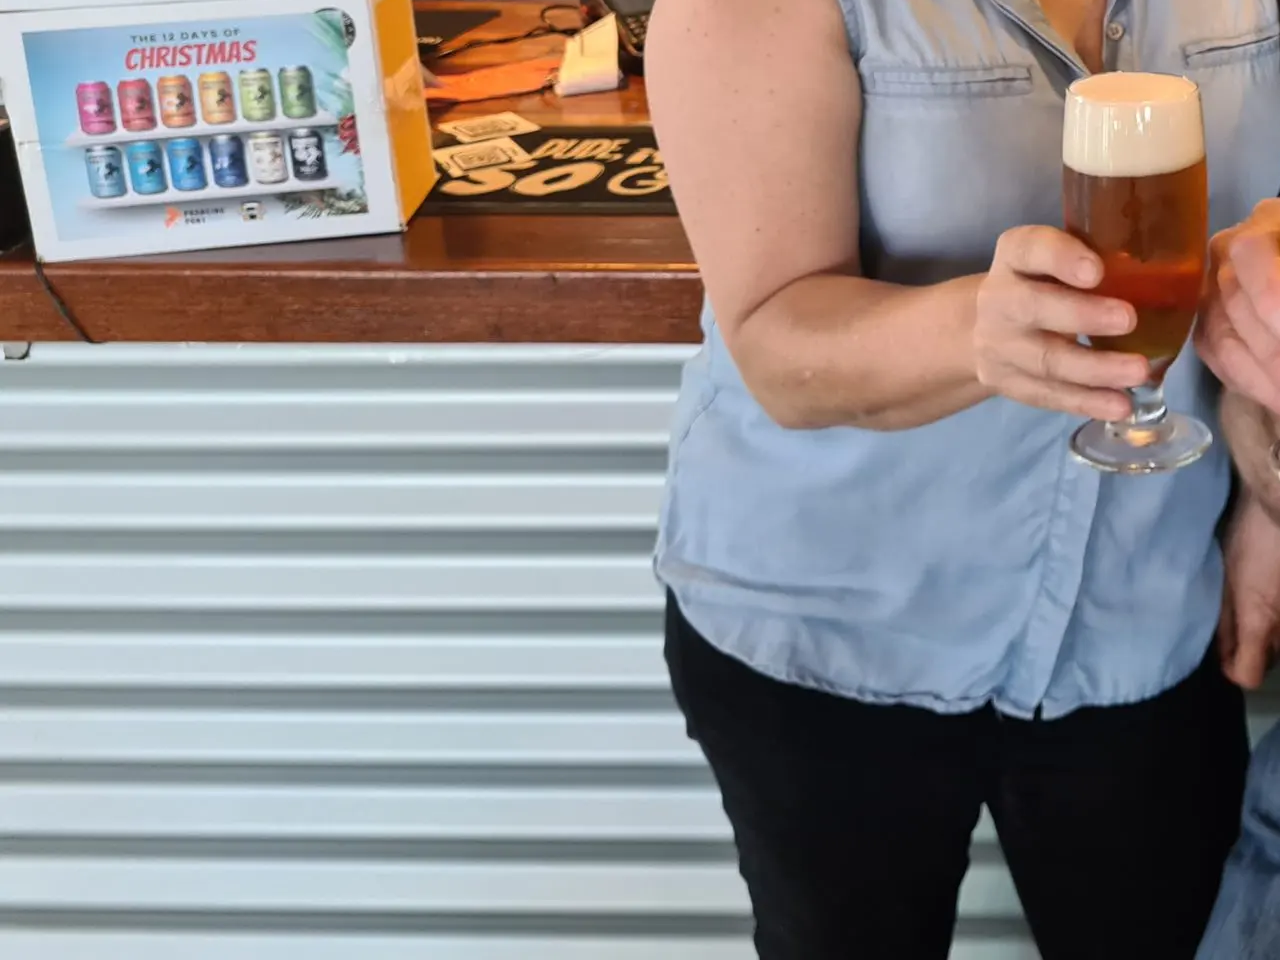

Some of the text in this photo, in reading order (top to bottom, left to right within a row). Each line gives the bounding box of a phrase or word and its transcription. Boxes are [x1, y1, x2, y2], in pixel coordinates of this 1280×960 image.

[130, 28, 240, 44] THE 12 DAYS OF
[124, 39, 257, 72] CHRISTMAS
